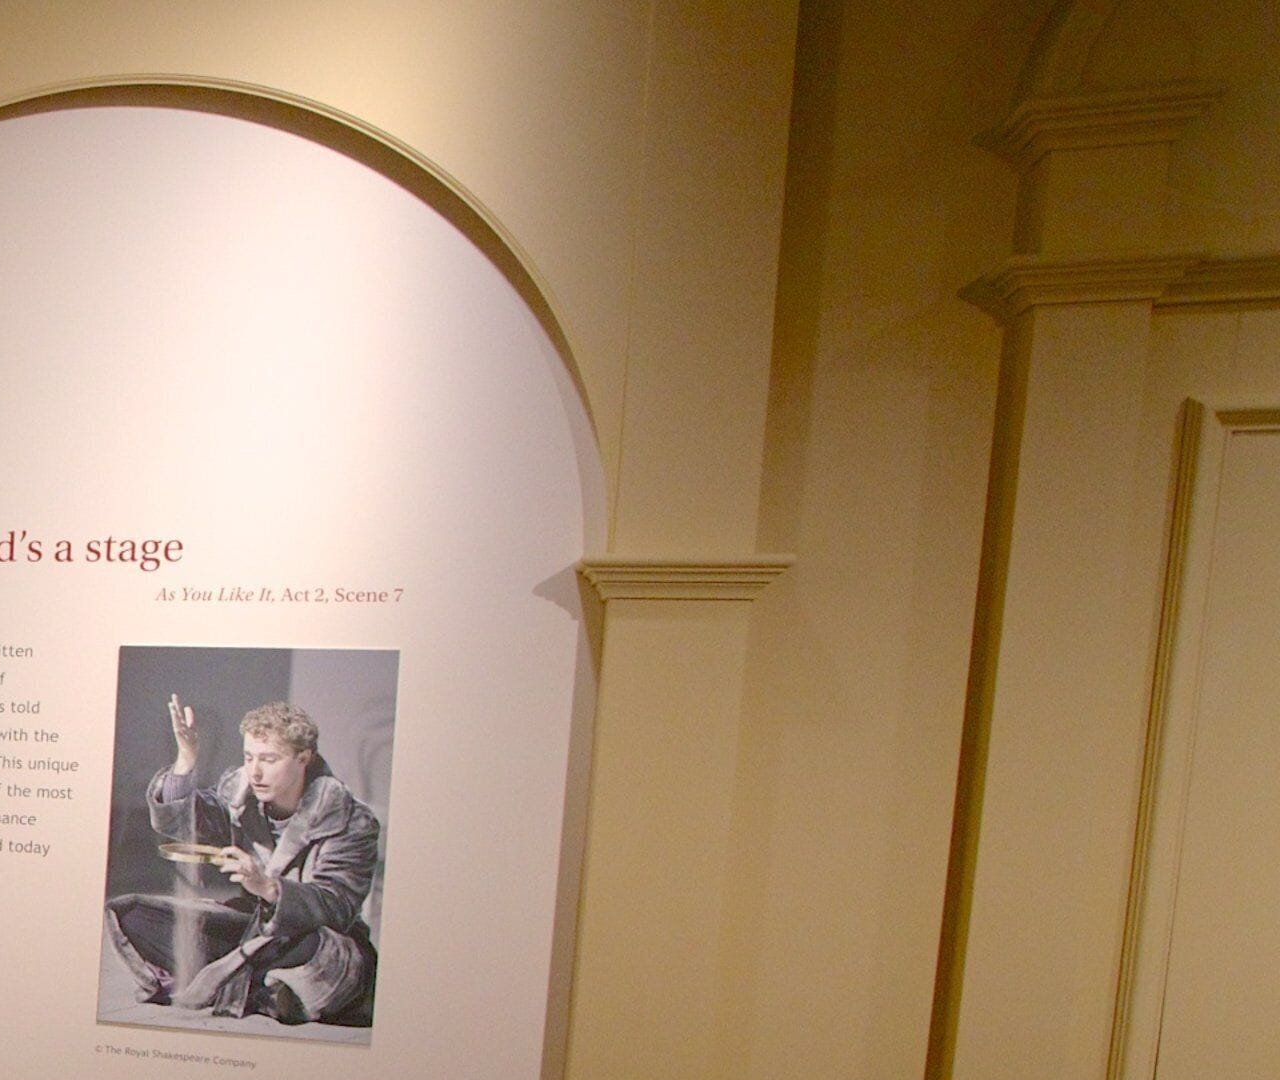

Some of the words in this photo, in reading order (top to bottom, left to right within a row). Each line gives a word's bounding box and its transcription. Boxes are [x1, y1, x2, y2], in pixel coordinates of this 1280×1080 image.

[53, 539, 74, 563] a
[85, 535, 184, 573] stage
[155, 588, 175, 601] As
[182, 587, 212, 601] You
[217, 587, 254, 602] Like
[258, 587, 275, 603] It,
[280, 587, 310, 602] Act
[314, 588, 329, 603] 2,
[334, 587, 389, 603] Scene
[394, 588, 404, 602] 7
[11, 701, 40, 714] told
[34, 729, 59, 743] the
[28, 758, 79, 774] unique
[7, 784, 31, 797] the
[37, 788, 72, 800] most
[9, 840, 51, 857] today
[105, 1045, 122, 1055] The
[125, 1047, 149, 1058] Royal
[152, 1049, 210, 1064] Shakespeare
[212, 1056, 257, 1070] Company
